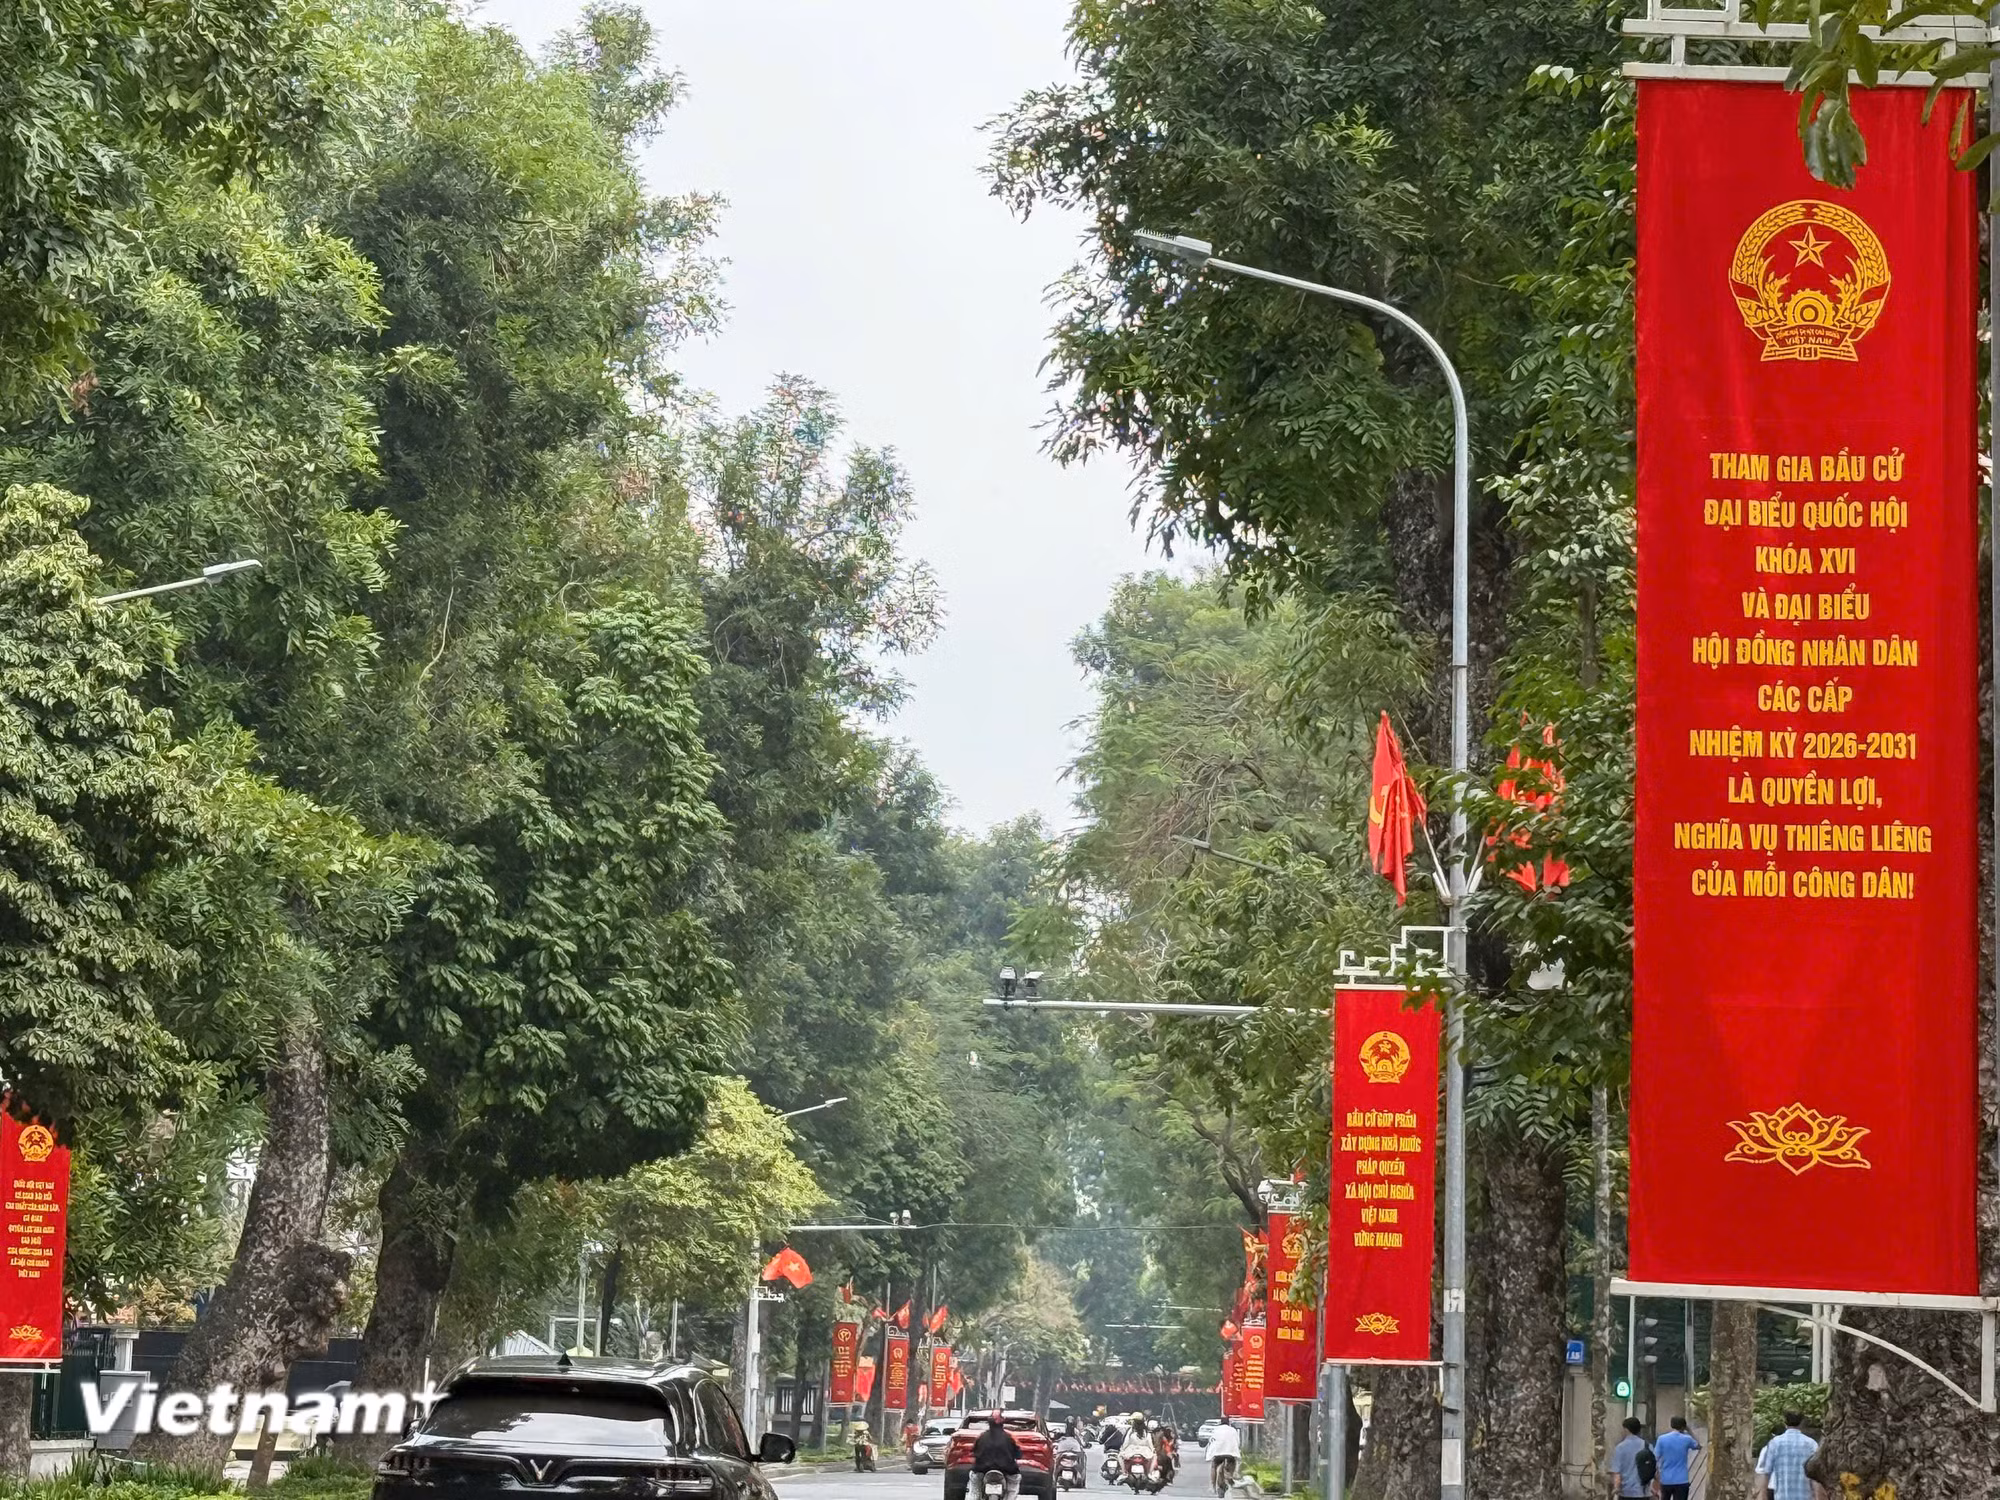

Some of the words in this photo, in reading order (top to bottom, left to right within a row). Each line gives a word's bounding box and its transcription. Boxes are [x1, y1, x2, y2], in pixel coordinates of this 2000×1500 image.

[1710, 453, 1769, 481] THAM
[1776, 456, 1813, 482] GIA
[1820, 447, 1865, 481] BẦU
[1872, 447, 1905, 481] CỬ
[1704, 499, 1742, 531] ĐẠI
[1748, 491, 1796, 528] BIỂU
[1803, 492, 1863, 530] QUỐC
[1870, 496, 1908, 533] HỘI
[1755, 542, 1812, 574] KHÓA
[1819, 548, 1856, 574] XVI
[1742, 587, 1770, 618] VÀ
[1774, 593, 1811, 626] ĐẠI
[1818, 583, 1870, 620] BIỂU
[1692, 632, 1730, 669] HỘI
[1736, 630, 1795, 666] ĐỒNG
[1802, 635, 1866, 667] NHÂN
[1872, 634, 1918, 667] DÂN
[1758, 680, 1800, 712] CÁC
[1807, 676, 1853, 713] CẤP
[1690, 725, 1763, 762] NHIỆM
[1769, 727, 1797, 759] KỲ
[1803, 733, 1916, 760] 2026-2031
[1728, 772, 1755, 804] LÀ
[1761, 770, 1833, 807] QUYỀN
[1840, 776, 1883, 810] LỢI,
[1674, 818, 1744, 850] NGHĨA
[1749, 824, 1778, 856] VỤ
[1784, 819, 1865, 852] THIÊNG
[1871, 820, 1932, 852] LIÊNG
[1691, 861, 1738, 897] CỦA
[1743, 861, 1786, 898] MỖI
[1792, 866, 1856, 898] CÔNG
[1862, 866, 1914, 899] DÂN!
